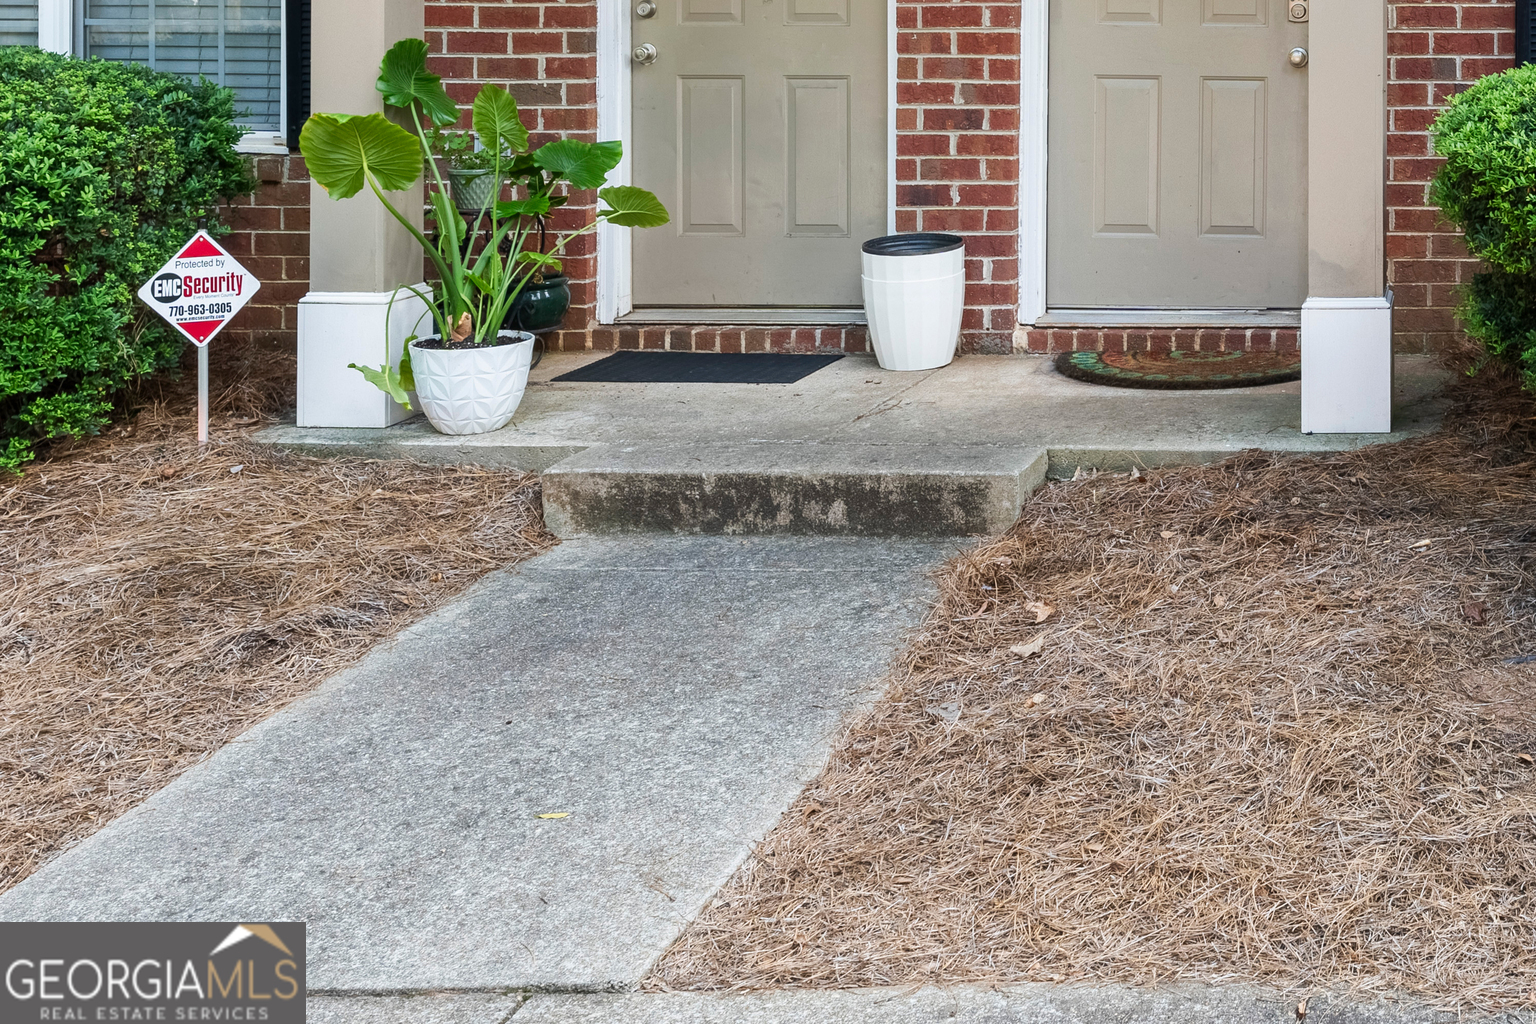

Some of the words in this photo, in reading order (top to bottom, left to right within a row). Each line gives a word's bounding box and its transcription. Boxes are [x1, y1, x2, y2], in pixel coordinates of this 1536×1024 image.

[175, 259, 213, 269] Protected
[215, 258, 225, 268] by
[169, 302, 232, 317] 770-963-0305
[176, 314, 225, 322] www.emcsecurity.com
